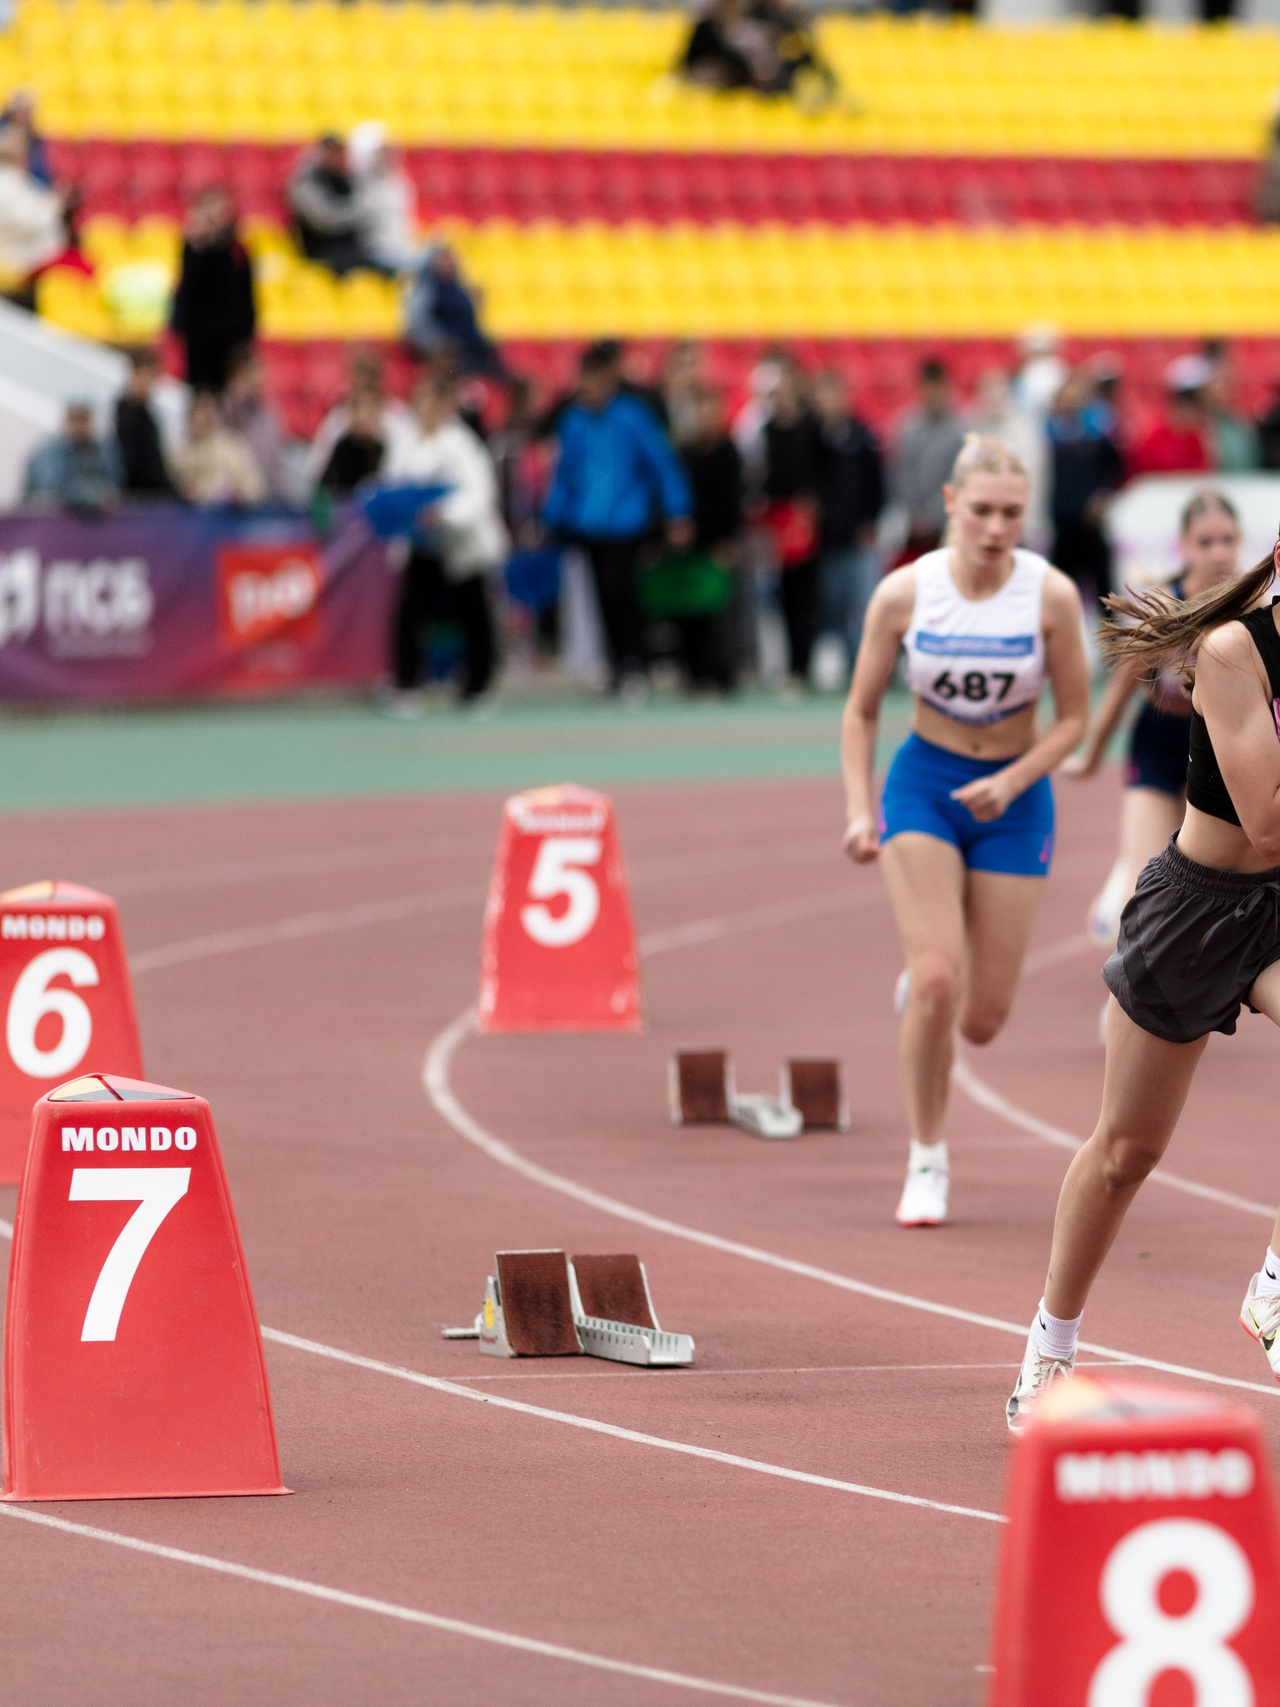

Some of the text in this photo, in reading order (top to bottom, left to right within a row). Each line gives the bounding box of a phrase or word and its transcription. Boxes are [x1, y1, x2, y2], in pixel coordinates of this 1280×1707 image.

[933, 671, 1016, 701] 687
[1, 915, 105, 940] MONDO
[521, 837, 602, 946] 5
[7, 947, 99, 1078] 6
[61, 1126, 197, 1152] MONDO
[68, 1167, 192, 1342] 7
[1056, 1450, 1254, 1501] MONDO
[1086, 1516, 1255, 1707] 8
